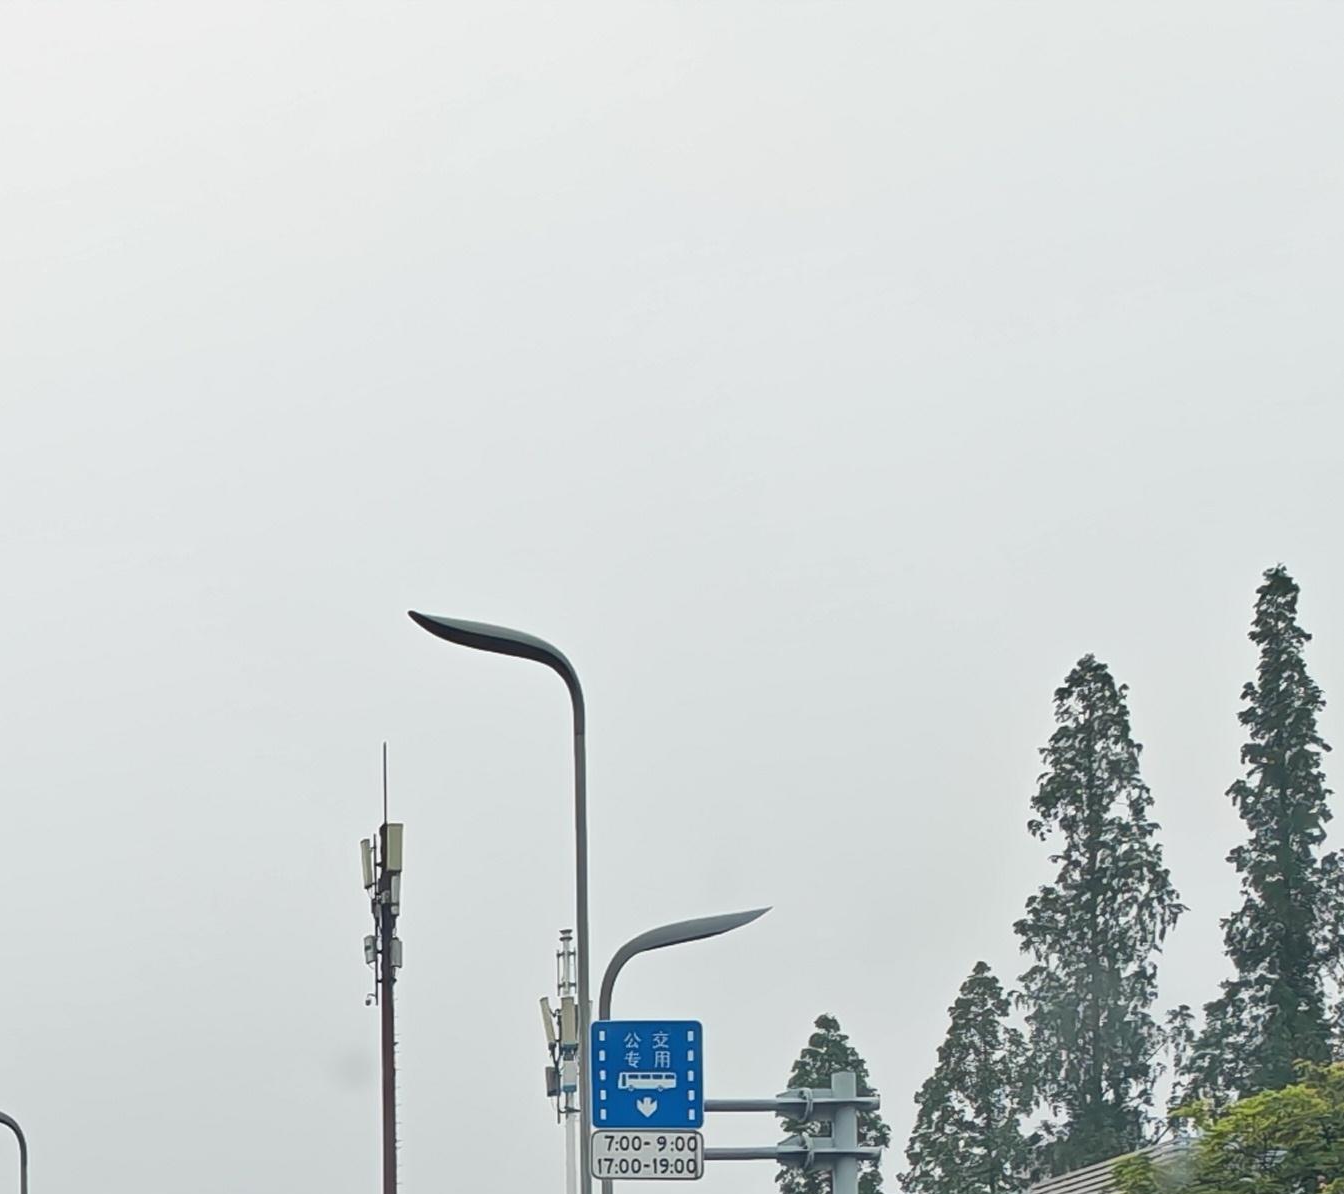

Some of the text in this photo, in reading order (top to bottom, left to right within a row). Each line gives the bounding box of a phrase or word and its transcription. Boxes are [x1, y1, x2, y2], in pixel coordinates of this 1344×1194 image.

[623, 1031, 670, 1049] 公交
[623, 1051, 671, 1069] 专用
[597, 1158, 697, 1174] 17:00-19:00
